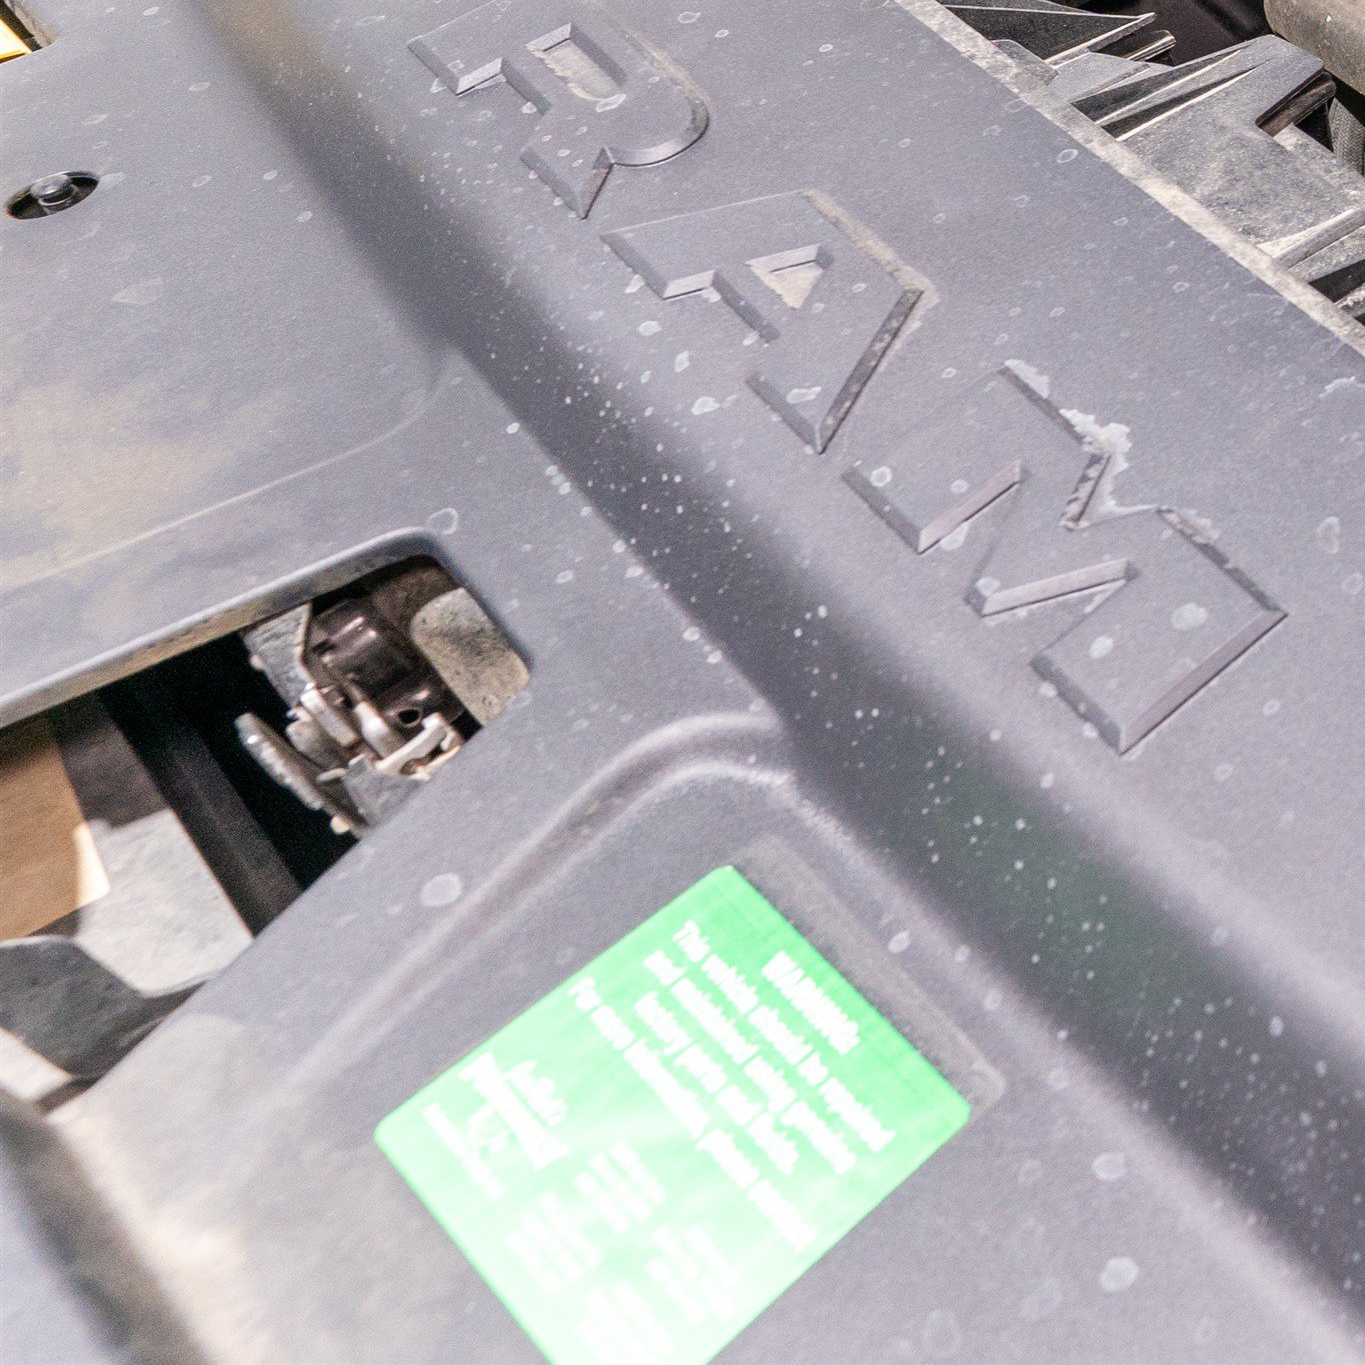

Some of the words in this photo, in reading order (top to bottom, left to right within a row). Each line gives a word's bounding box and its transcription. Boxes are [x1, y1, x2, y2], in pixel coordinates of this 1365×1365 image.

[568, 976, 601, 1010] For
[591, 1005, 633, 1048] more
[697, 1130, 757, 1186] please
[635, 992, 688, 1052] factory
[676, 1046, 725, 1090] parts
[717, 1086, 759, 1123] and
[643, 949, 684, 984] and
[674, 980, 755, 1061] maintained
[745, 1058, 794, 1110] using
[783, 1103, 855, 1172] genuine
[672, 919, 710, 961] This
[703, 955, 757, 1011] vehicle
[750, 1006, 810, 1063] should
[797, 1053, 828, 1084] be
[821, 1079, 894, 1149] repaired
[764, 953, 857, 1051] WARNING:
